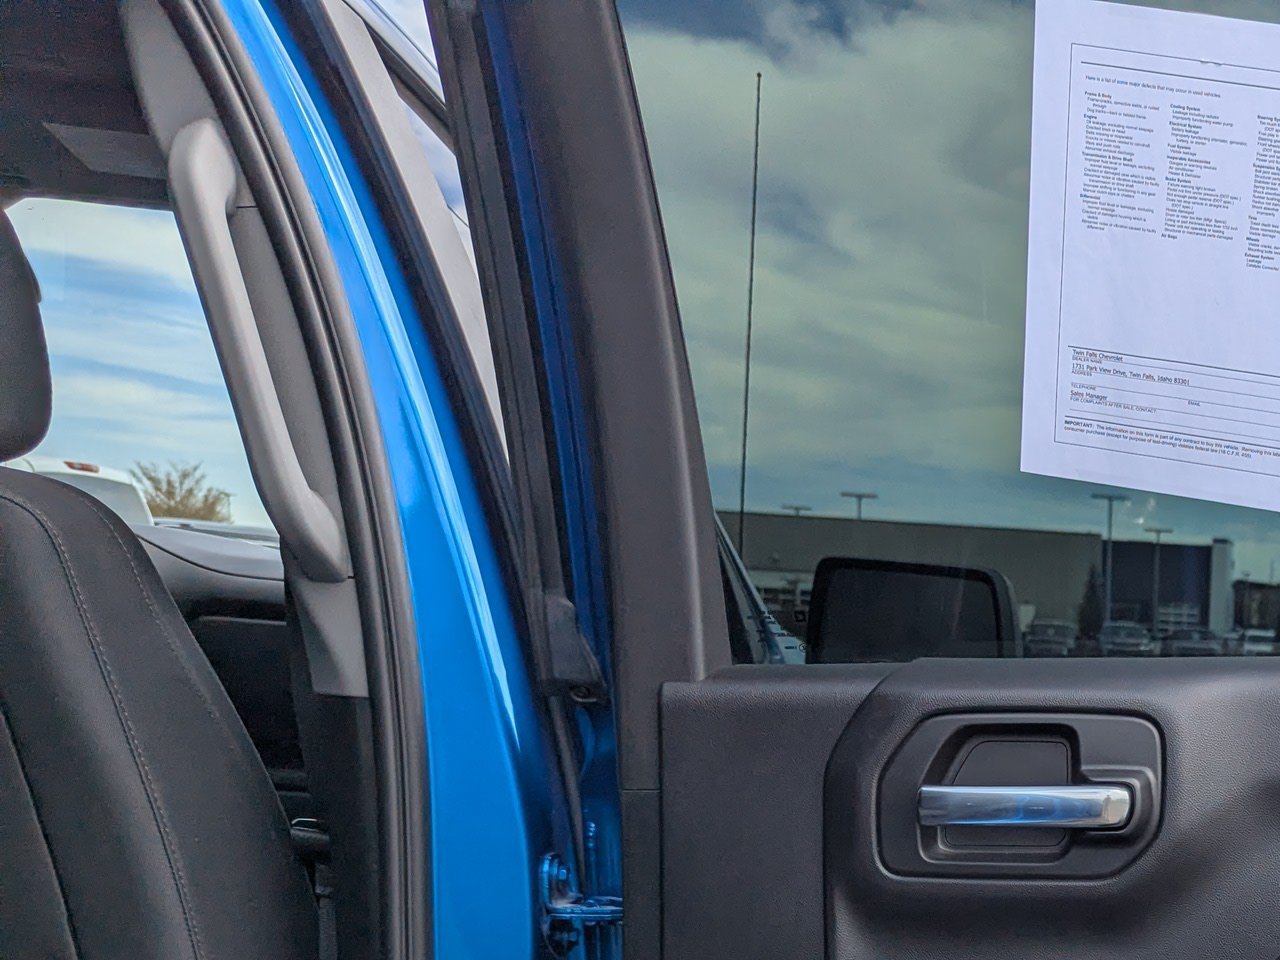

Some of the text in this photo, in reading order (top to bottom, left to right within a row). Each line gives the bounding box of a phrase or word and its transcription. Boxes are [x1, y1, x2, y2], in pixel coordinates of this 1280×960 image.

[1099, 353, 1123, 362] Chevrolet
[1099, 366, 1112, 374] View
[1113, 369, 1128, 377] Drive,
[1142, 373, 1156, 381] Falls,
[1158, 375, 1173, 383] Idaho
[1086, 392, 1107, 402] Manager
